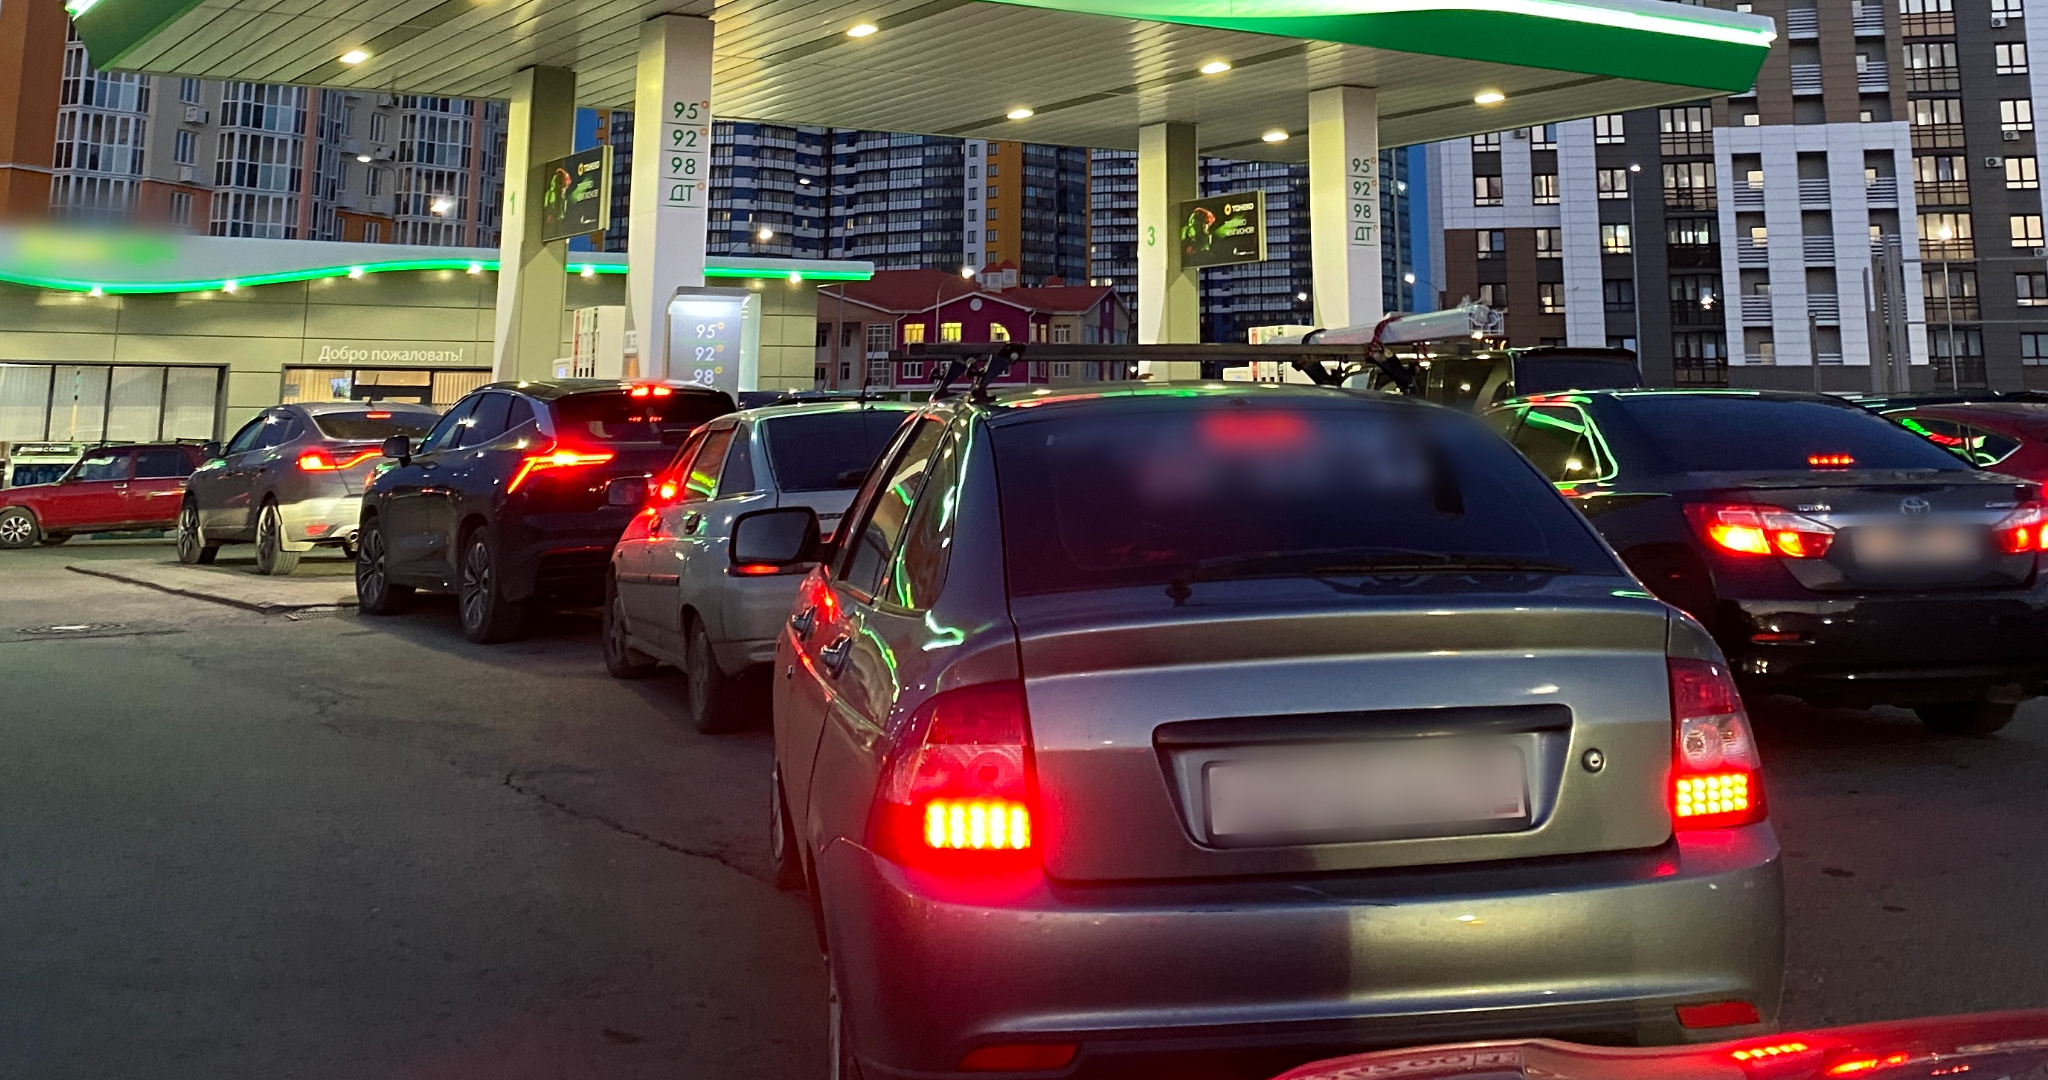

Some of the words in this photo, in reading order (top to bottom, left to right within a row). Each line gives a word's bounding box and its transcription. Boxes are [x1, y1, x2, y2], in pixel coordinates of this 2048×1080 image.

[674, 101, 699, 119] 95
[672, 129, 697, 147] 92
[671, 156, 696, 174] 98
[1352, 158, 1370, 173] 95
[669, 184, 696, 202] ДТ
[1353, 181, 1371, 196] 92
[510, 191, 516, 216] 1
[1354, 204, 1371, 218] 98
[1147, 225, 1155, 247] 3
[1354, 226, 1372, 241] ДТ
[696, 323, 717, 339] 95
[318, 345, 368, 363] Добро
[371, 348, 464, 362] пожаловать!
[695, 346, 715, 361] 92
[693, 368, 715, 385] 98
